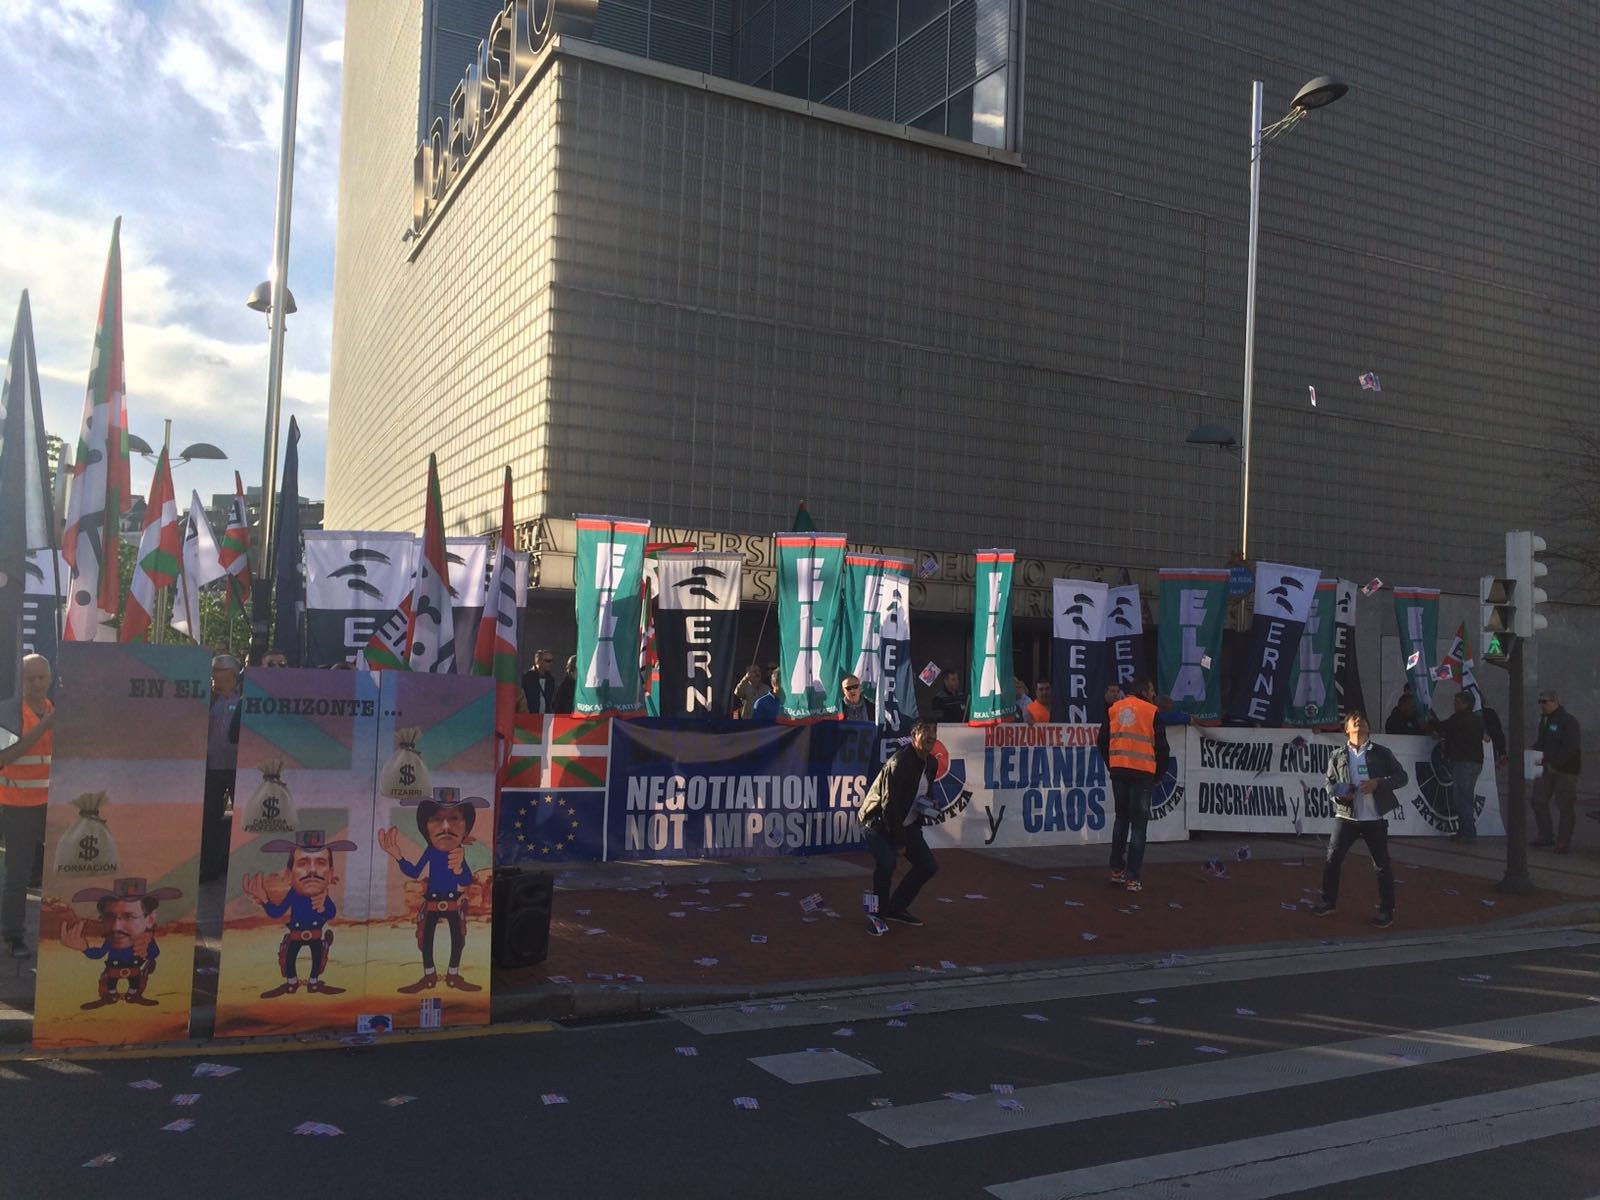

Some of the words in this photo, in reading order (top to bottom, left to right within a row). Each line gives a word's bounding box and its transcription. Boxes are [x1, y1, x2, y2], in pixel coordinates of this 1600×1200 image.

[585, 543, 628, 687] ELA
[791, 558, 826, 694] ELA
[686, 616, 712, 712] ERN
[1115, 640, 1135, 684] ER
[1170, 589, 1208, 702] ELA
[129, 678, 165, 698] EN
[173, 679, 206, 698] EL
[1069, 645, 1087, 724] ERN
[1247, 622, 1286, 720] ERNE
[245, 699, 375, 717] HORIZONTE
[985, 726, 1064, 747] HORIZONTE
[1199, 736, 1273, 772] ESTEFANIA
[1280, 742, 1340, 774] ENCHU
[984, 747, 1106, 789] LEJANIA
[626, 775, 817, 810] NEGOTIATION
[827, 775, 868, 808] YES
[1198, 782, 1288, 817] DISCRIMINA
[1304, 786, 1336, 818] ESC
[625, 813, 688, 850] NOT
[703, 810, 863, 848] IMPOSITION
[985, 805, 1005, 844] y
[1022, 788, 1106, 833] CAOS
